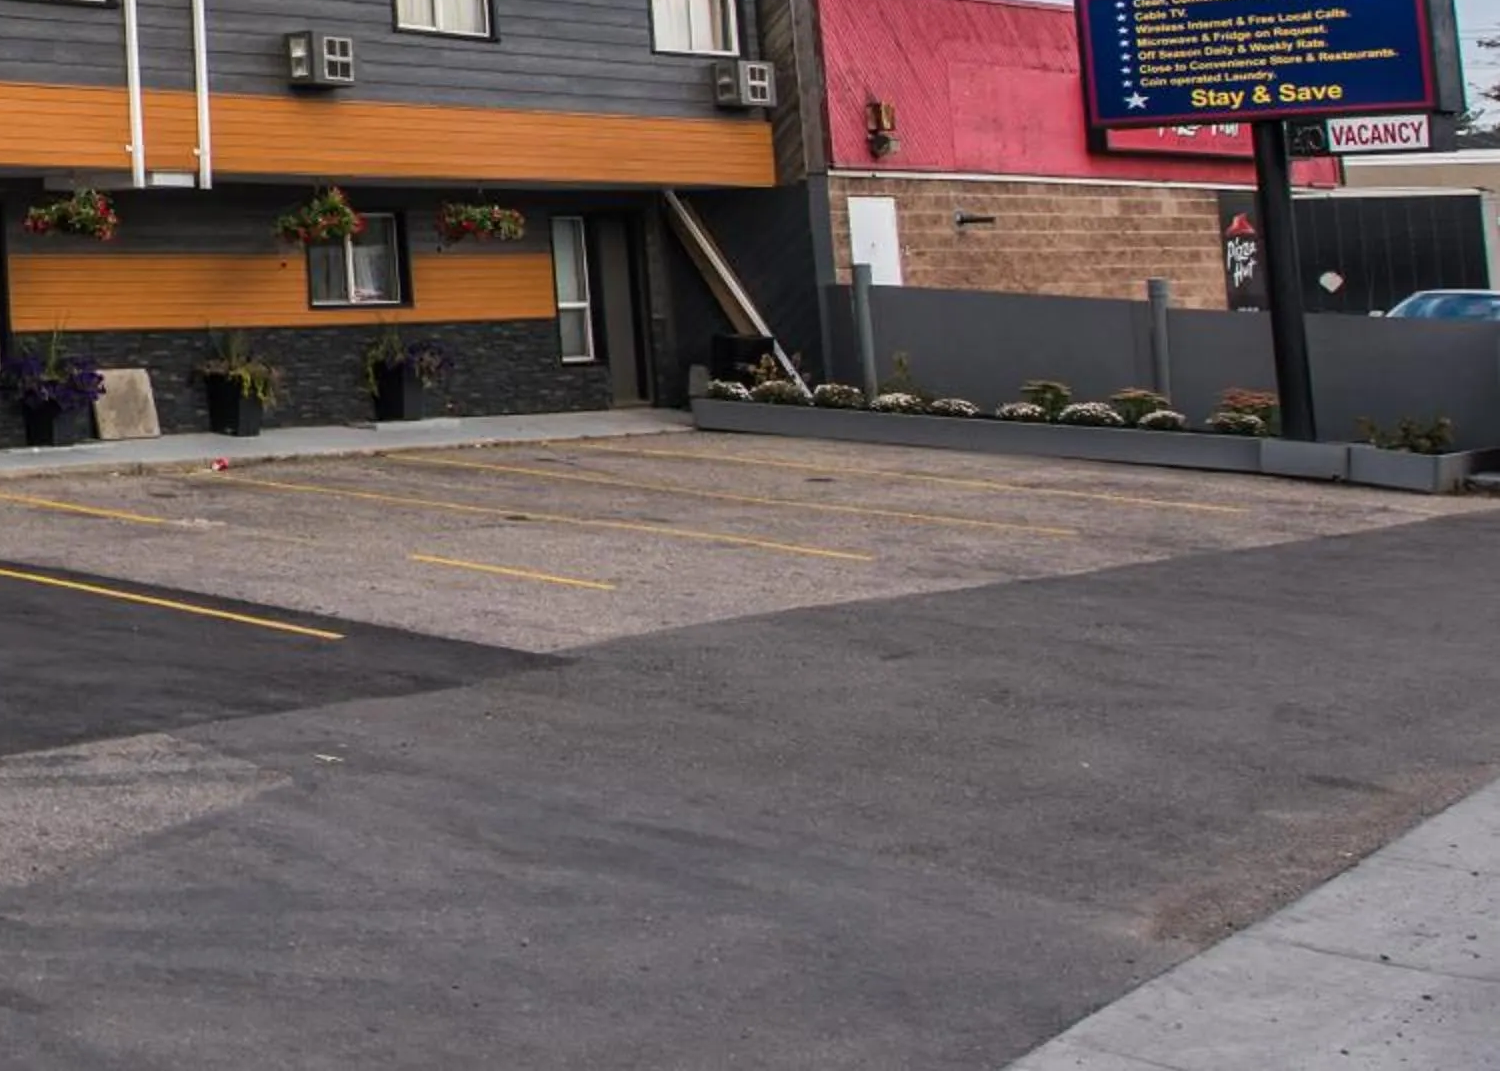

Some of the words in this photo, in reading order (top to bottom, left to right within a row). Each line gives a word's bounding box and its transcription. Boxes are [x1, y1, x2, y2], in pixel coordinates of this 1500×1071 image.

[1134, 10, 1167, 22] Cable
[1135, 23, 1185, 34] Wireless
[1187, 18, 1233, 30] Internet
[1235, 16, 1245, 26] &
[1248, 14, 1275, 25] Free
[1278, 11, 1312, 22] Local
[1136, 35, 1198, 48] Microwave
[1201, 32, 1211, 42] &
[1213, 31, 1252, 42] Fridge
[1254, 29, 1271, 38] on
[1138, 49, 1156, 61] Off
[1158, 48, 1202, 59] Season
[1203, 45, 1234, 56] Daily
[1237, 44, 1247, 54] &
[1249, 41, 1293, 52] Weekly
[1140, 63, 1173, 74] Close
[1175, 62, 1187, 71] to
[1189, 58, 1267, 70] Convenience
[1269, 54, 1303, 66] Store
[1305, 51, 1316, 62] &
[1140, 76, 1168, 87] Coin
[1170, 73, 1221, 86] operated
[1190, 88, 1244, 109] Stay
[1252, 85, 1271, 104] &
[1279, 83, 1343, 103] Save
[1331, 121, 1423, 146] VACANCY
[1227, 236, 1256, 270] Pizza
[1233, 258, 1257, 288] Hut
